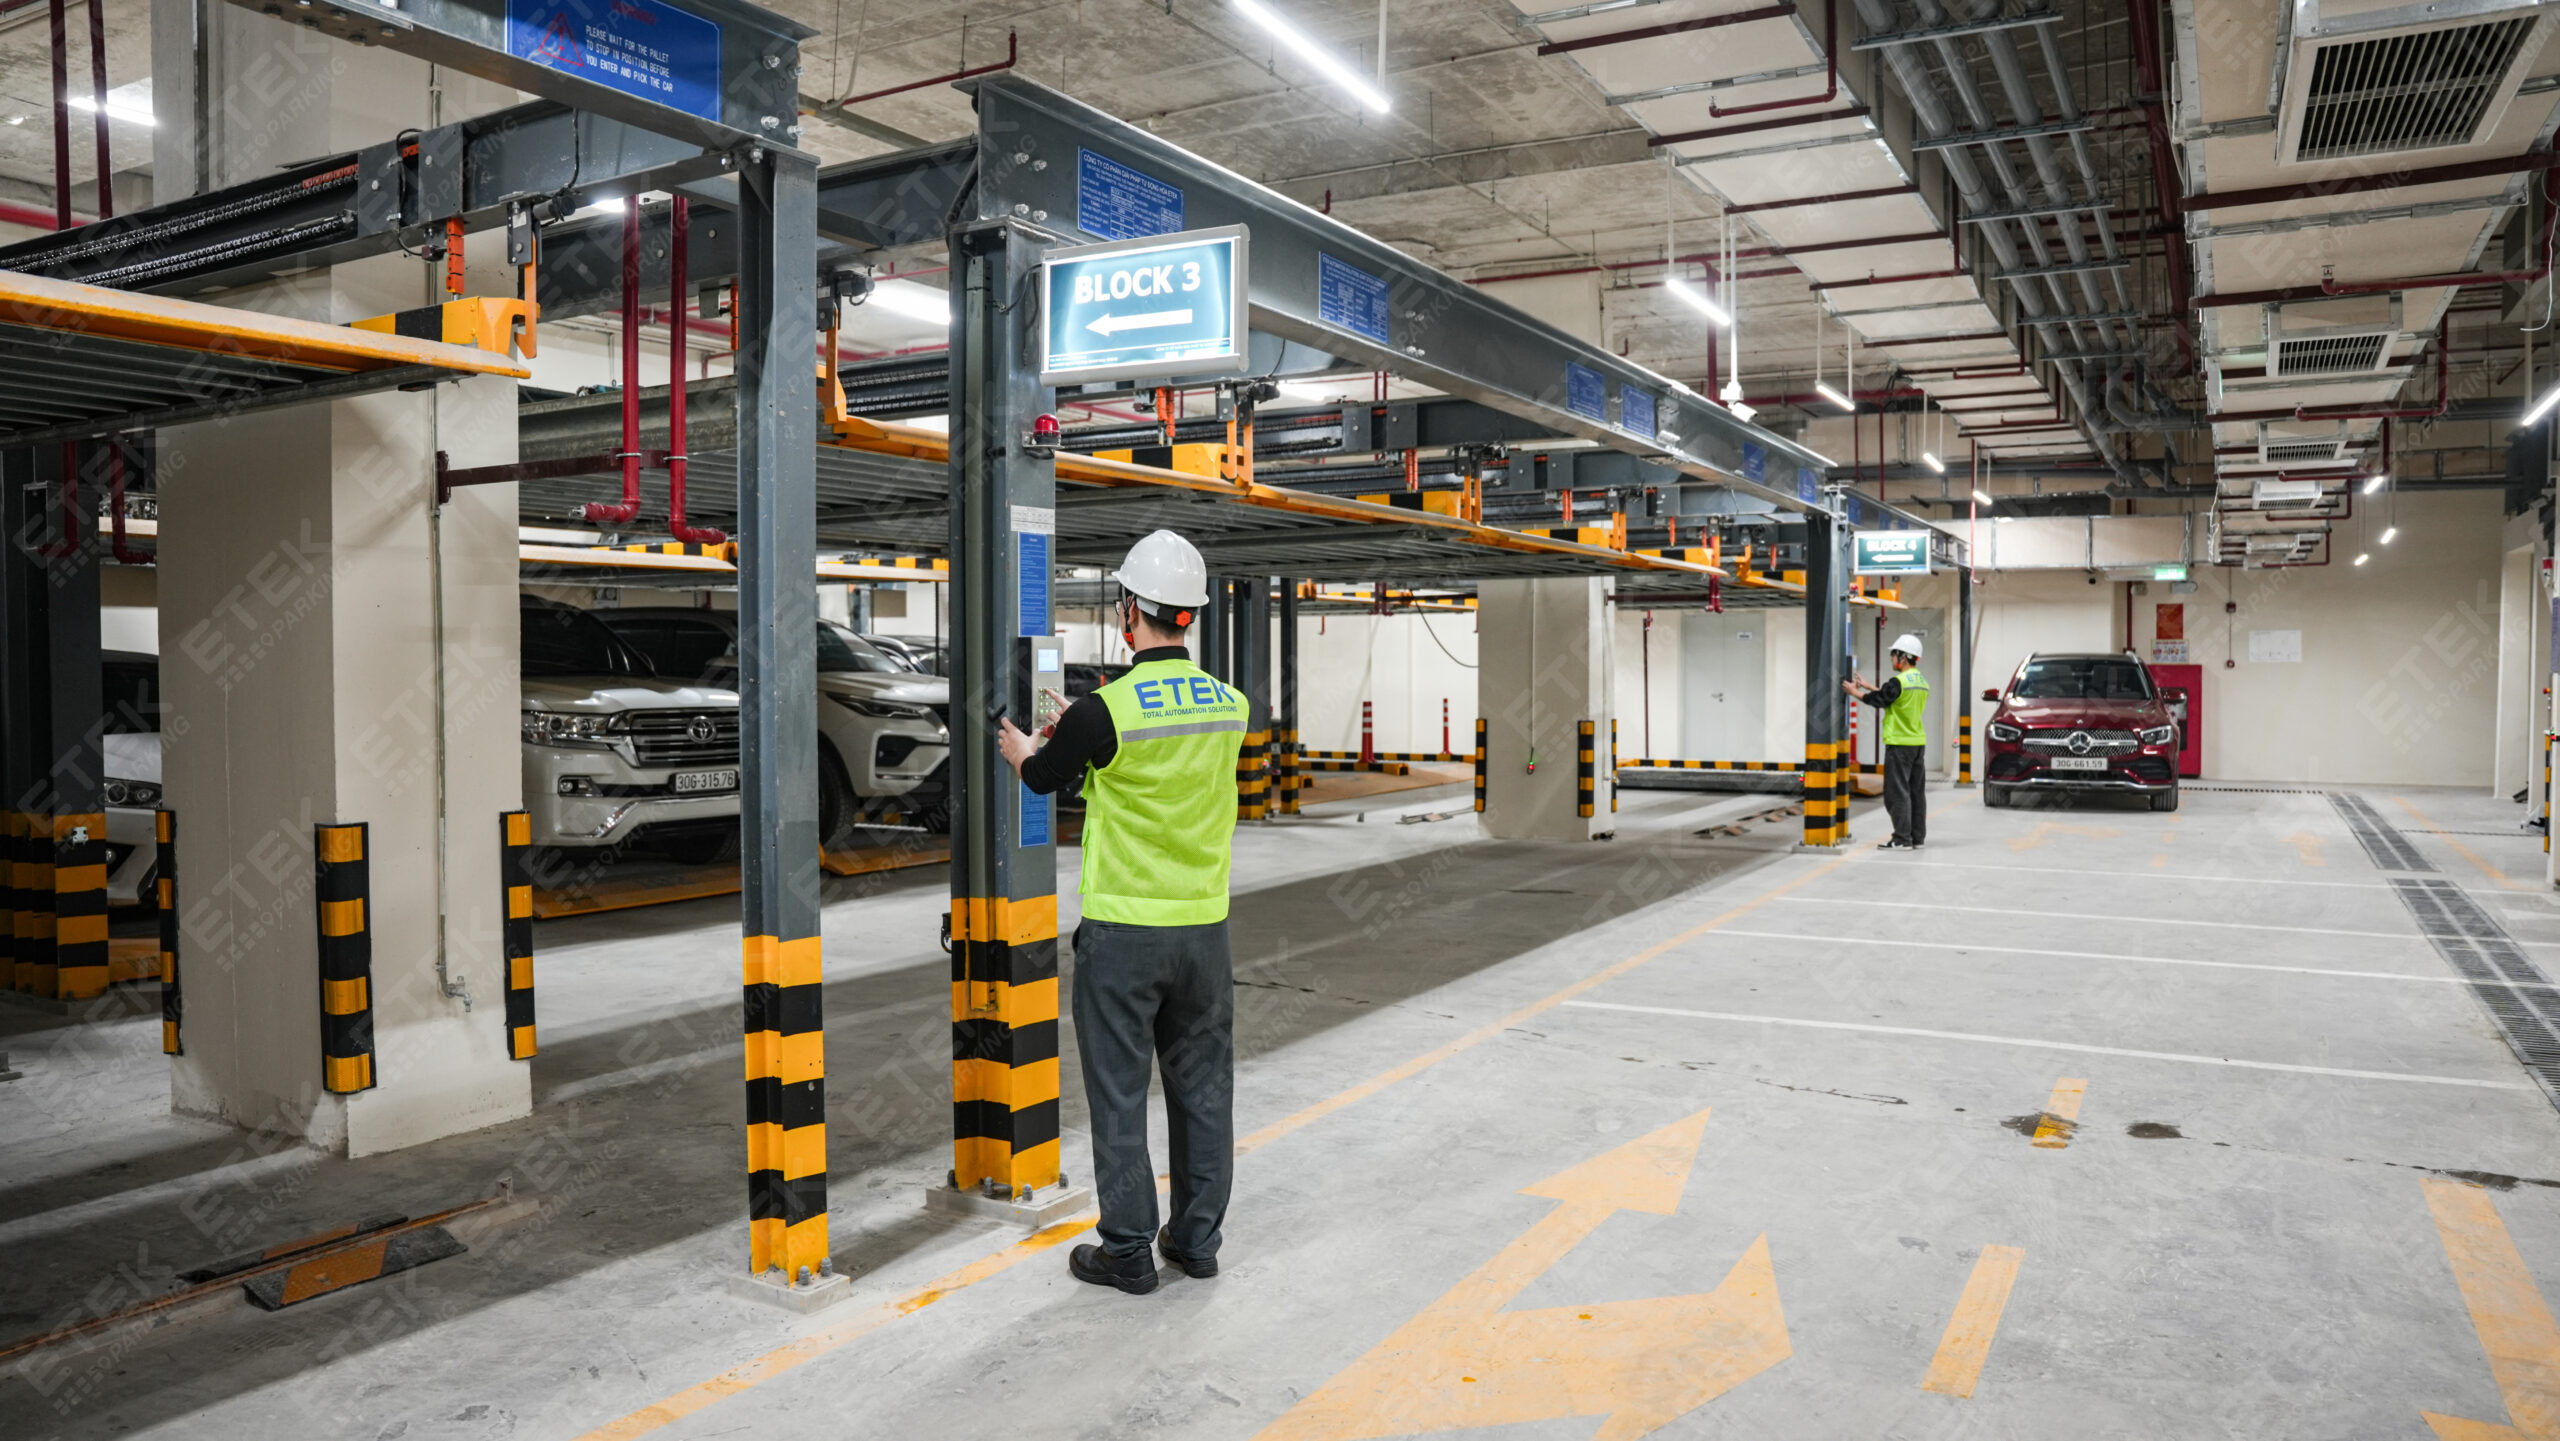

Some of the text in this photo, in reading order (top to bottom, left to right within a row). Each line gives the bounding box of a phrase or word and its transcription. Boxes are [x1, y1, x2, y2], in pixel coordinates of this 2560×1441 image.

[586, 25, 669, 64] PLEASE WAIT FOR THE PALLET
[586, 40, 593, 51] TO
[596, 44, 610, 56] STOP
[613, 49, 620, 60] IN
[649, 62, 670, 78] BEFORE
[586, 54, 674, 93] YOU ENTER AND PICK THE CAR
[1074, 261, 1201, 304] BLOCK 3
[1866, 540, 1917, 552] BLOCK 4
[1134, 677, 1236, 710] ETEK
[1142, 705, 1237, 719] TOTAL AUTOMATION SOLUTIONS
[678, 772, 734, 790] 30G-315.76
